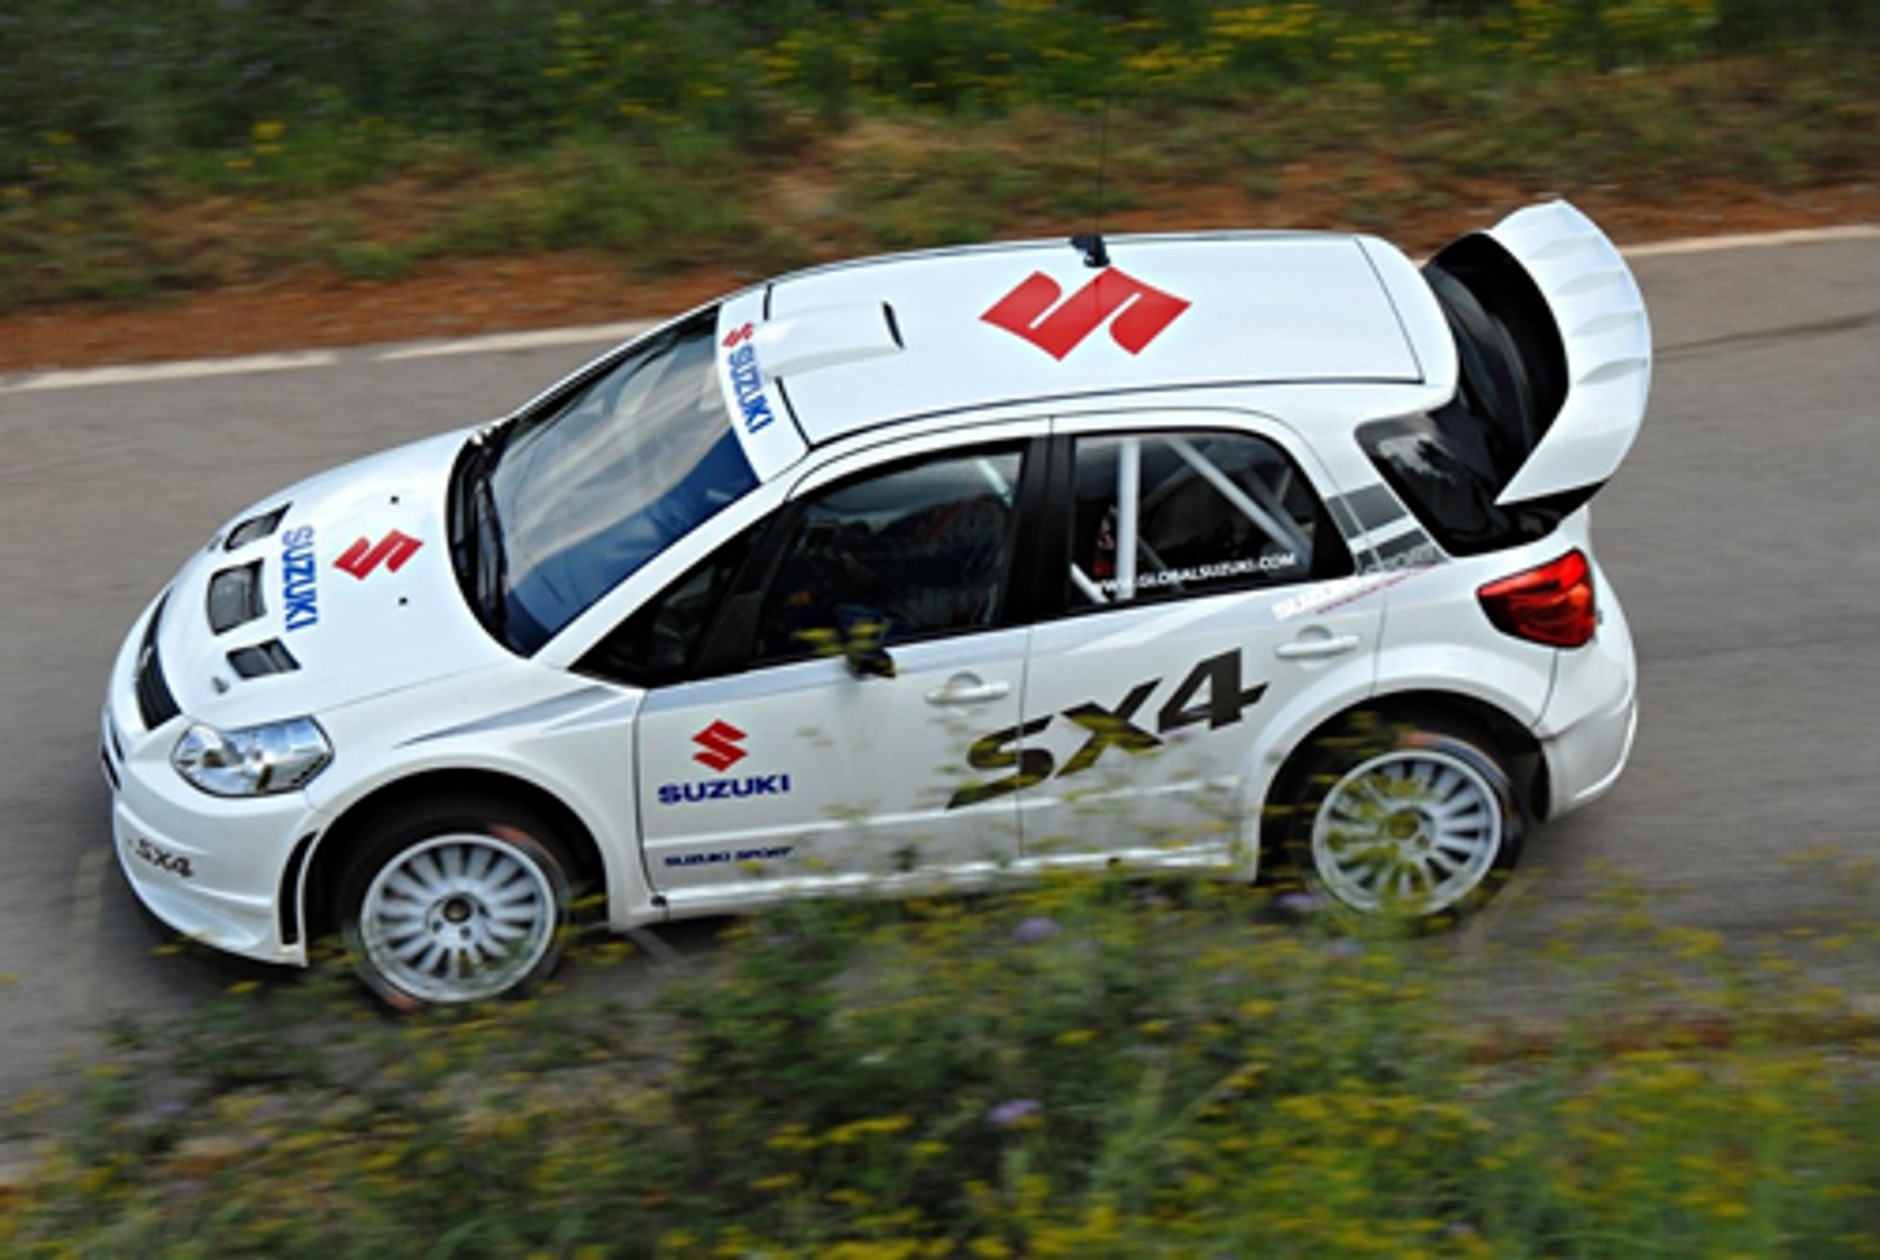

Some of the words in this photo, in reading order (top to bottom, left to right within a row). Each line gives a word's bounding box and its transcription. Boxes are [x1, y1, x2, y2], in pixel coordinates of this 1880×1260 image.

[727, 344, 774, 434] SUZUKI
[282, 525, 317, 632] SUZUKI
[946, 647, 1268, 809] SX4
[658, 774, 791, 804] SUZUKI
[136, 839, 194, 878] SX4
